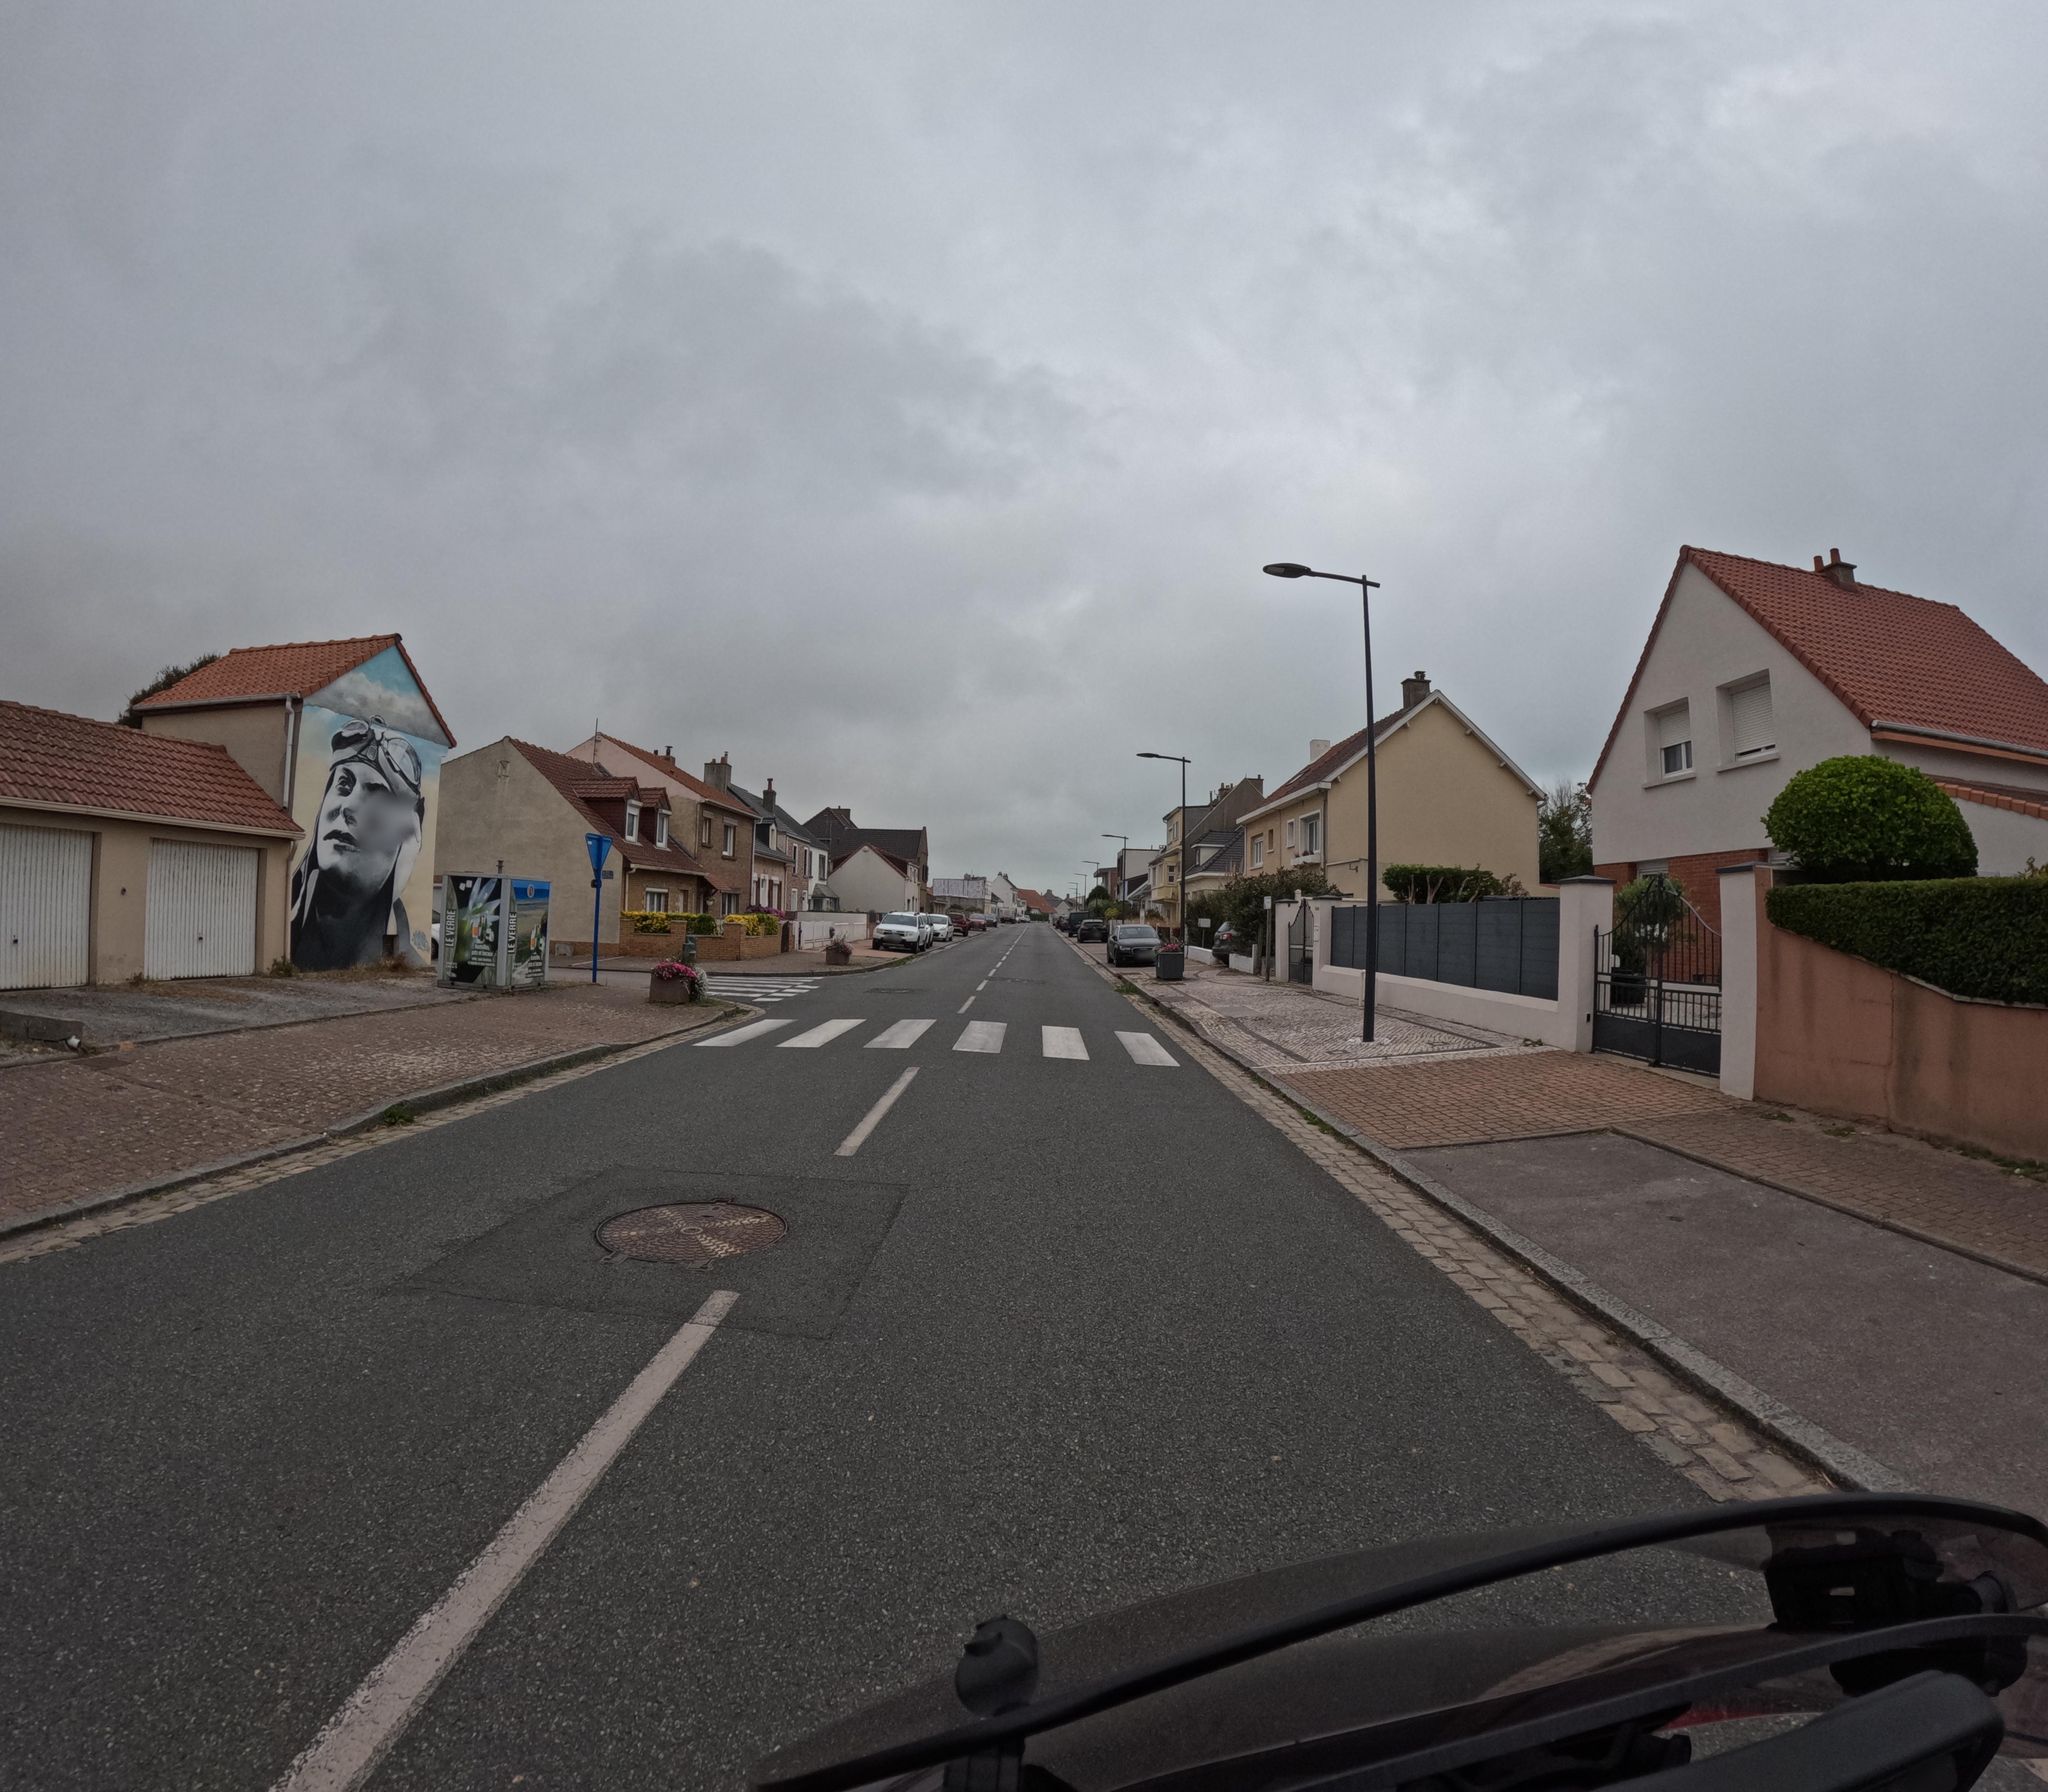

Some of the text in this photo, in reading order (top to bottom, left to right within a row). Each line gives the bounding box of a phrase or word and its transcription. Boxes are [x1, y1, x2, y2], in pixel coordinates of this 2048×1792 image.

[445, 909, 456, 947] LE VERRE
[508, 912, 517, 953] LE VERRE
